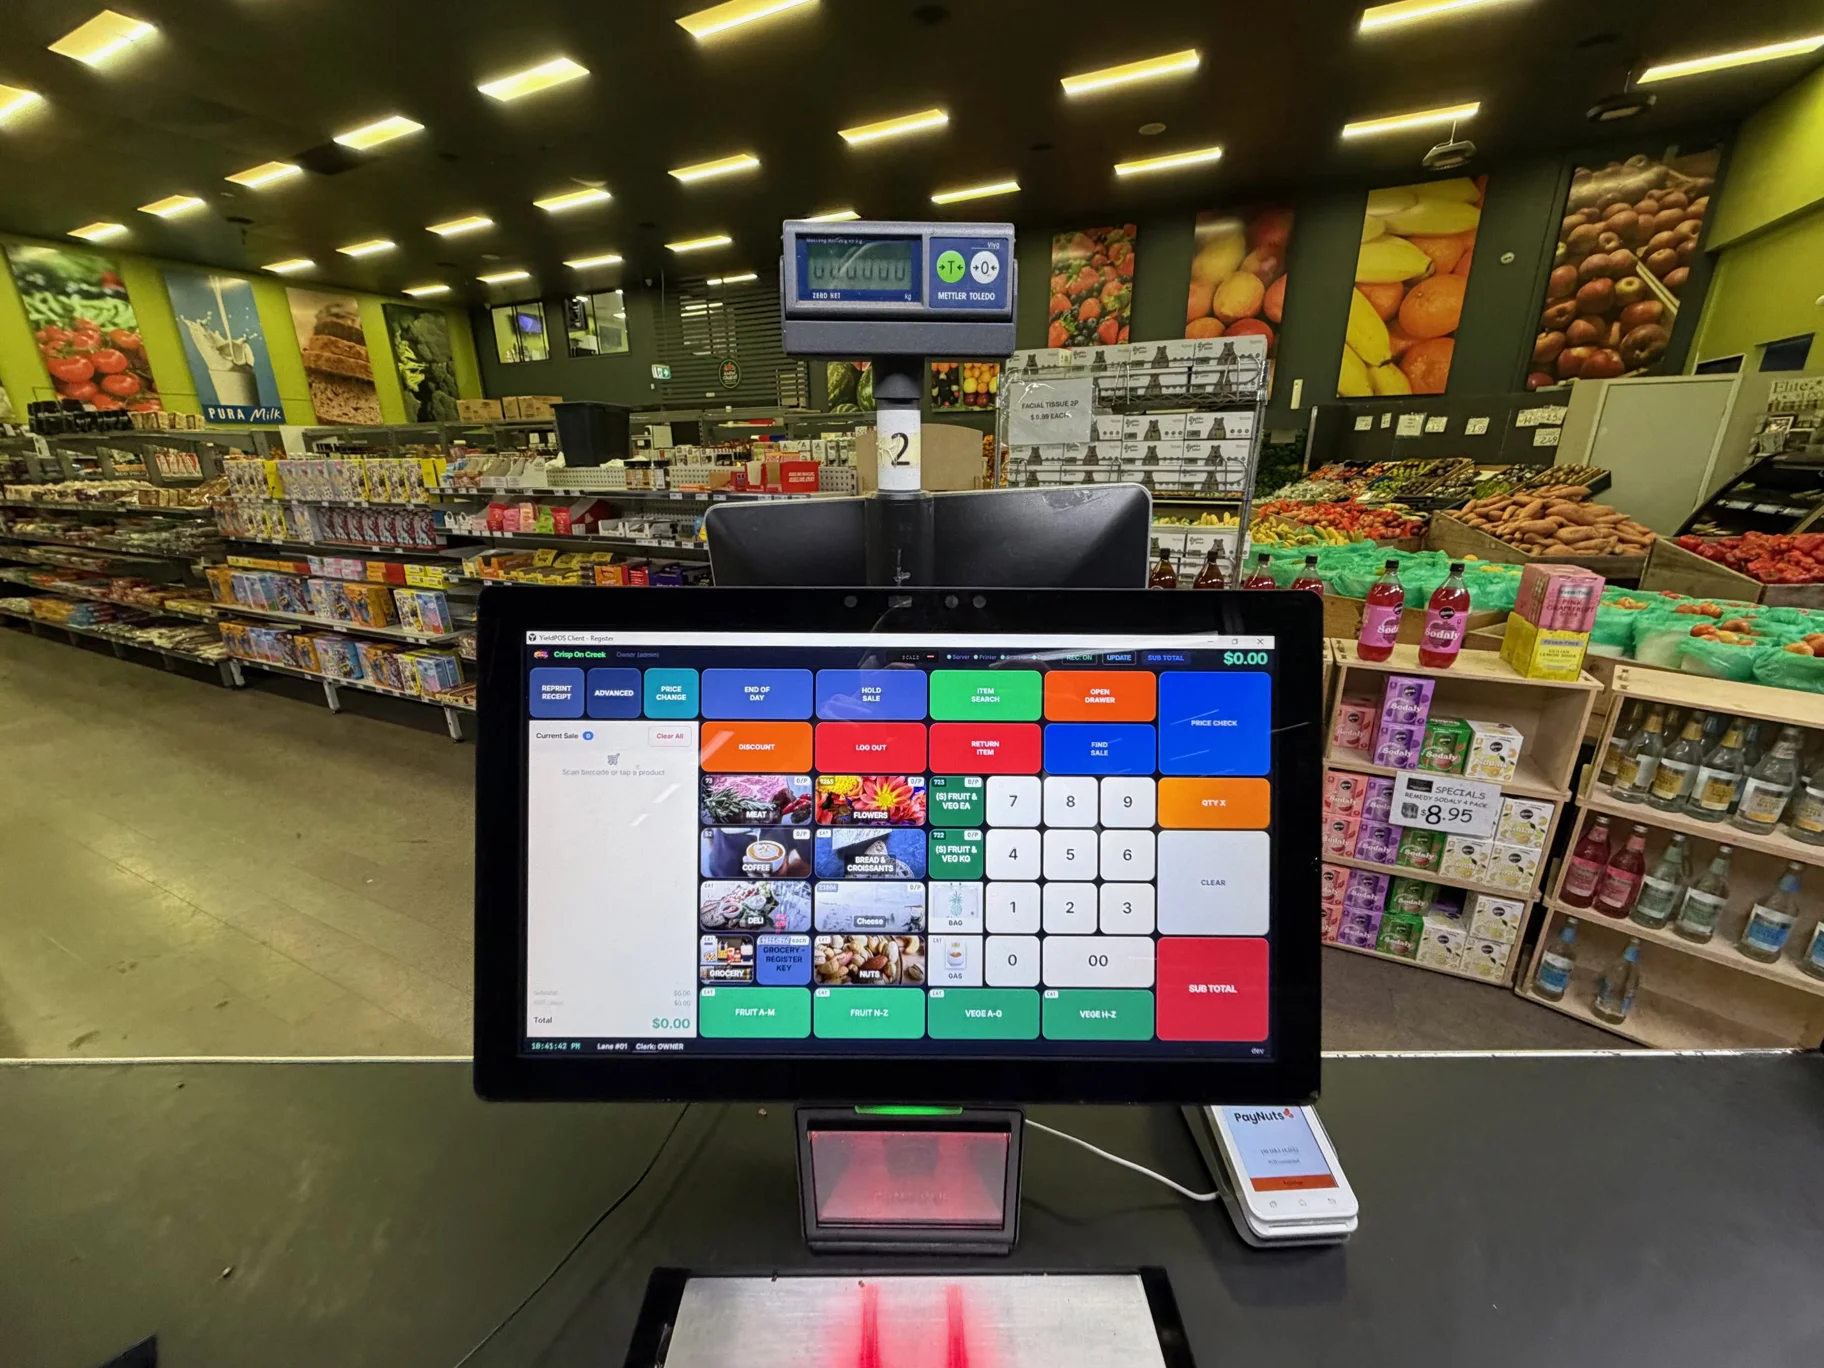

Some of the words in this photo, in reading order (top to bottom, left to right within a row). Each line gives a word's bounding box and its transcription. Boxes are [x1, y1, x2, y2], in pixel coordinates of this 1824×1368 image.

[904, 293, 912, 301] kg
[938, 292, 967, 300] METTLER
[969, 292, 996, 300] TOLEDO
[1046, 400, 1069, 408] TISSUE
[208, 408, 246, 420] PURA
[250, 408, 282, 422] Milk
[890, 432, 910, 468] 2
[590, 634, 614, 643] Register
[1424, 627, 1461, 642] Sodaly
[554, 651, 573, 659] Crisp
[1223, 651, 1268, 666] $0.00
[1390, 702, 1423, 713] Sodaly
[536, 732, 562, 740] Current
[564, 732, 579, 740] Sale
[656, 732, 674, 740] Clear
[674, 732, 684, 740] All
[1382, 747, 1414, 758] Sodaly
[1426, 750, 1458, 762] Sodaly
[562, 768, 580, 776] Scan
[620, 770, 632, 778] tap
[638, 769, 666, 778] product
[936, 792, 947, 801] (S)
[1434, 786, 1487, 800] SPECIALS
[1009, 795, 1018, 808] 7
[1066, 796, 1076, 808] 8
[1123, 796, 1132, 808] 9
[1404, 792, 1434, 801] REMEDY
[1434, 795, 1462, 805] SODALY
[1470, 801, 1488, 809] PACK
[854, 811, 888, 820] FLOWERS
[1420, 804, 1474, 825] $8.95
[936, 846, 946, 854] (S)
[947, 846, 971, 854] FRUIT
[1362, 843, 1392, 854] Sodaly
[942, 855, 958, 863] VEG
[959, 855, 970, 863] KG
[1008, 848, 1018, 860] 4
[1066, 849, 1075, 861] 5
[1123, 849, 1132, 861] 6
[1404, 848, 1435, 860] Sodaly
[855, 856, 878, 864] BREAD
[742, 864, 770, 872] COFFEE
[847, 864, 894, 872] CROISSANTS
[1350, 890, 1380, 901] Sodaly
[1398, 896, 1426, 906] Sodaly
[1010, 901, 1016, 913] 1
[1066, 902, 1075, 914] 2
[1122, 902, 1132, 914] 3
[856, 918, 884, 926] Cheese
[1344, 928, 1372, 939] Sodaly
[1384, 936, 1412, 948] Sodaly
[763, 946, 800, 954] GROCERY
[1008, 954, 1018, 966] 0
[1088, 954, 1108, 967] 00
[709, 970, 745, 978] GROCERY
[859, 970, 880, 978] NUTS
[1188, 984, 1208, 994] SUB
[1208, 984, 1238, 994] TOTAL
[736, 1008, 758, 1016] FRUIT
[758, 1008, 776, 1016] A-M
[850, 1009, 873, 1017] FRUIT
[874, 1009, 888, 1017] N-Z
[965, 1010, 987, 1018] VEGE
[988, 1010, 1002, 1018] A-G
[1080, 1010, 1101, 1018] VEGE
[1102, 1010, 1117, 1018] H-Z
[652, 1017, 690, 1030] $0.00
[570, 1042, 580, 1050] PM
[597, 1042, 614, 1050] Lane
[636, 1042, 656, 1051] Clerk:
[1250, 1046, 1264, 1055] dev
[1234, 1111, 1285, 1124] PayNuts
